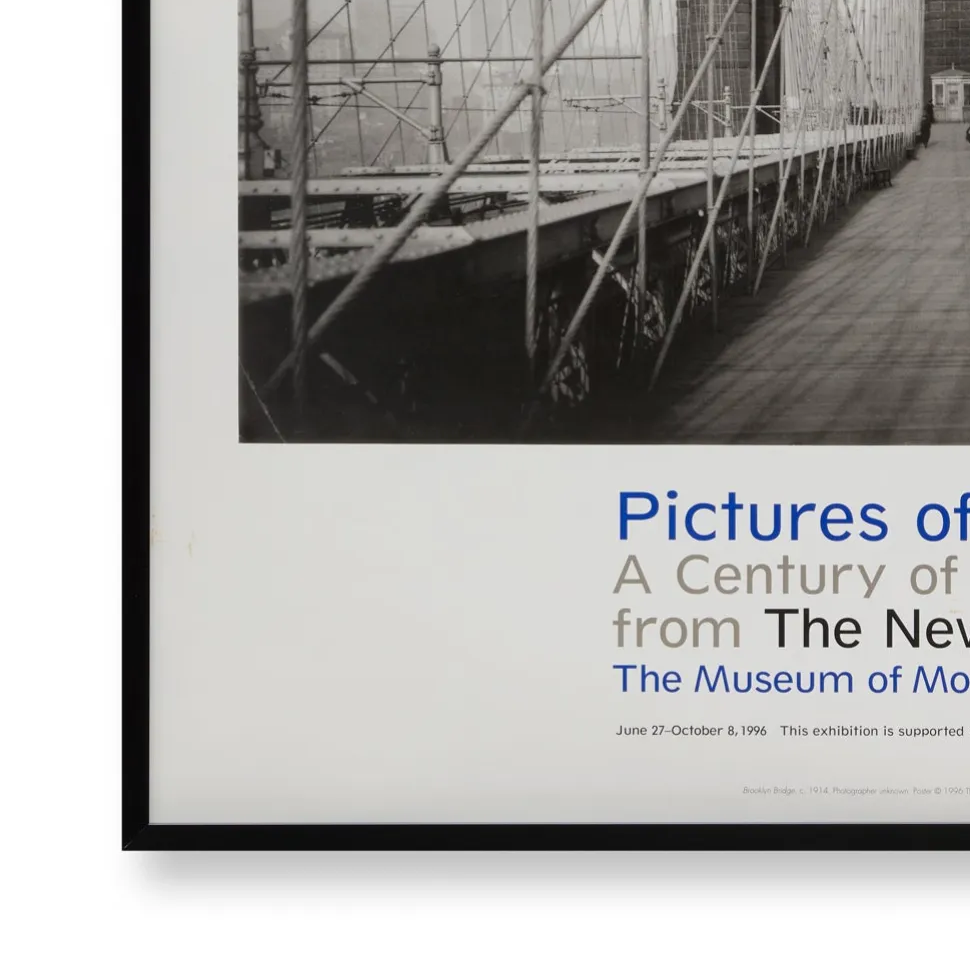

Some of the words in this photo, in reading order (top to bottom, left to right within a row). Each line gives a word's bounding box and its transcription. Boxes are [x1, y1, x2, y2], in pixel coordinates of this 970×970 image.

[619, 490, 889, 542] Pictures
[613, 555, 652, 594] A
[677, 554, 886, 598] Century
[909, 555, 959, 595] of
[612, 608, 741, 648] from
[764, 608, 862, 648] The
[612, 664, 682, 693] The
[694, 665, 854, 693] Museum
[867, 665, 903, 693] of
[616, 724, 648, 736] June
[741, 725, 767, 736] 1996
[779, 725, 809, 737] This
[812, 725, 879, 737] exhibition
[883, 725, 894, 737] is
[898, 725, 964, 739] supported
[742, 785, 771, 797] Brooklyn
[832, 785, 877, 798] Photographer
[944, 786, 964, 795] 1996
